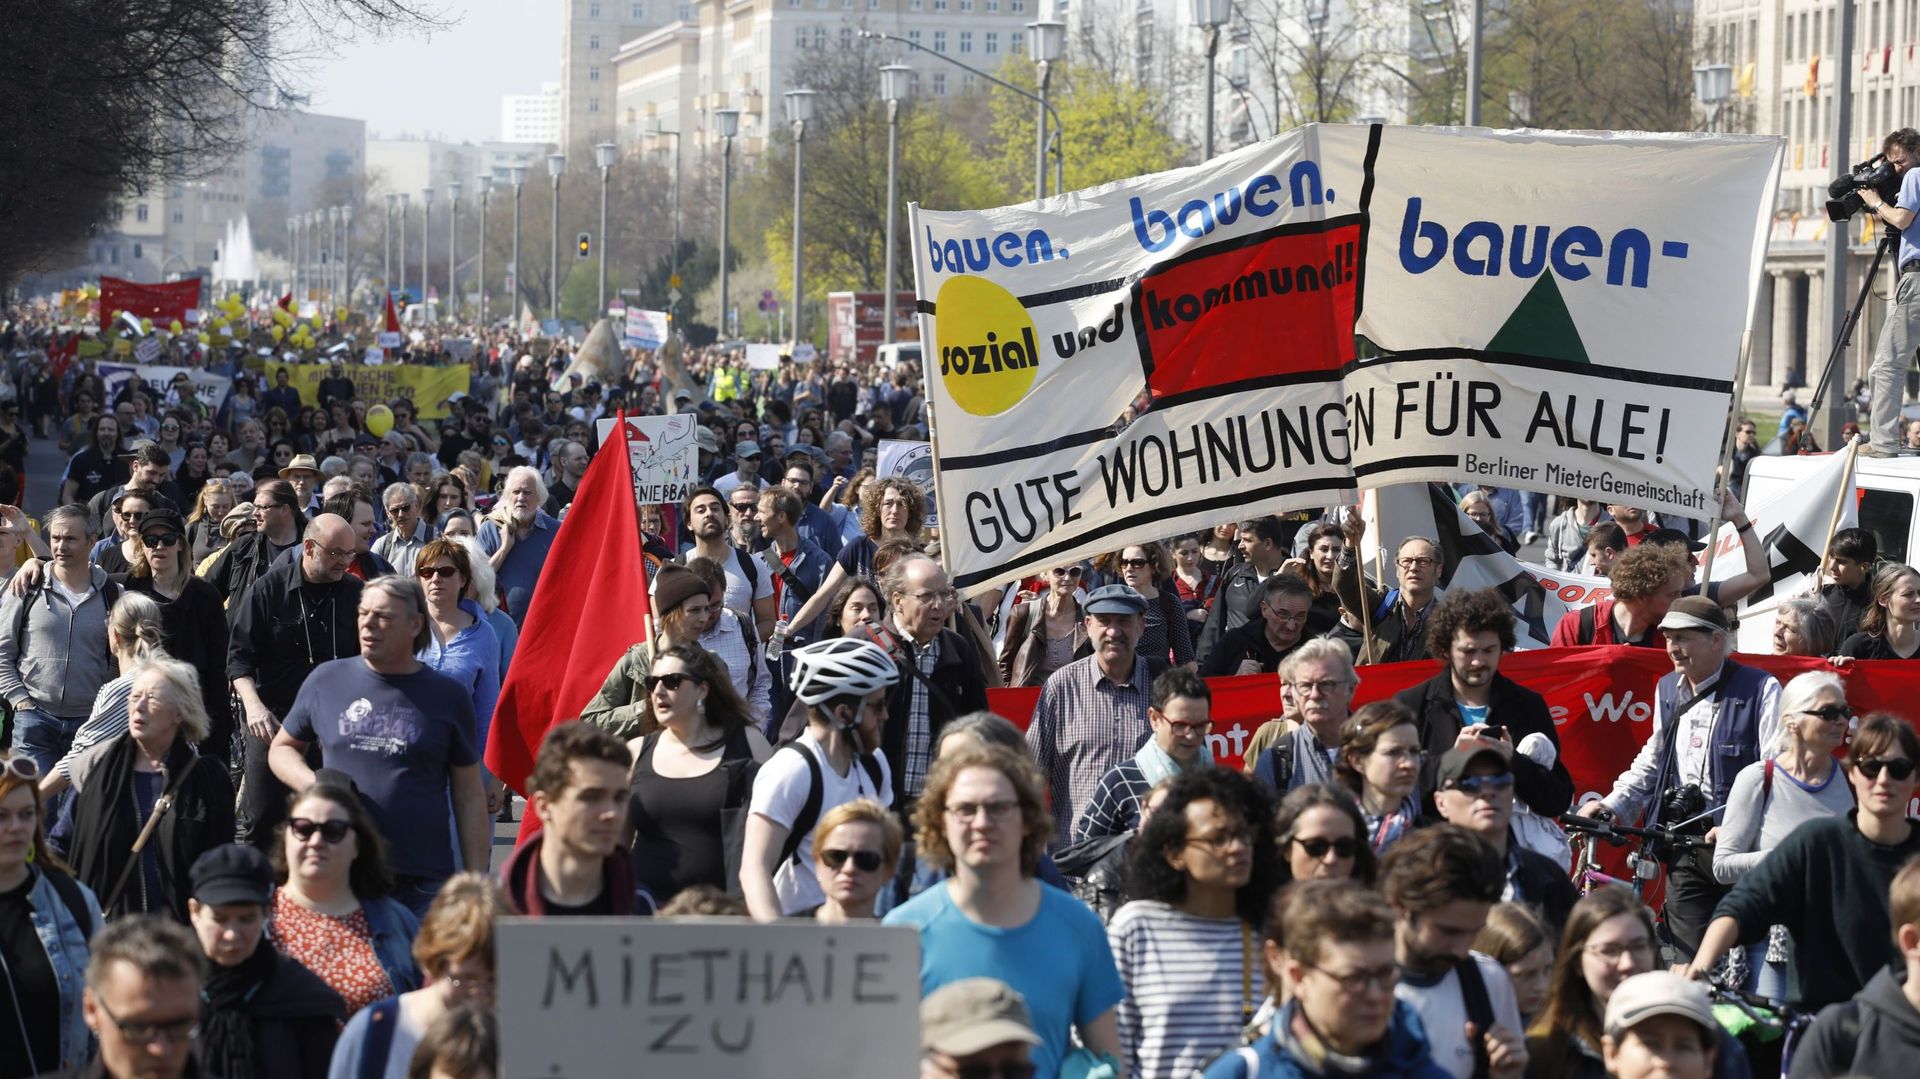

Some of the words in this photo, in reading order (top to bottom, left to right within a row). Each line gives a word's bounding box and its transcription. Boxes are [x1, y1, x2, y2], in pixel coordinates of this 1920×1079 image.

[1399, 197, 1689, 288] bauen-
[941, 326, 1039, 377] sozial
[1052, 304, 1124, 359] und
[1147, 241, 1354, 331] kommunal!
[965, 470, 1081, 554] GUTE
[1394, 372, 1502, 440] FÜR
[1525, 390, 1671, 464] ALLE!
[1465, 453, 1539, 481] Berliner
[1545, 463, 1706, 510] MieterGemeinschaft
[647, 1014, 755, 1055] ZU
